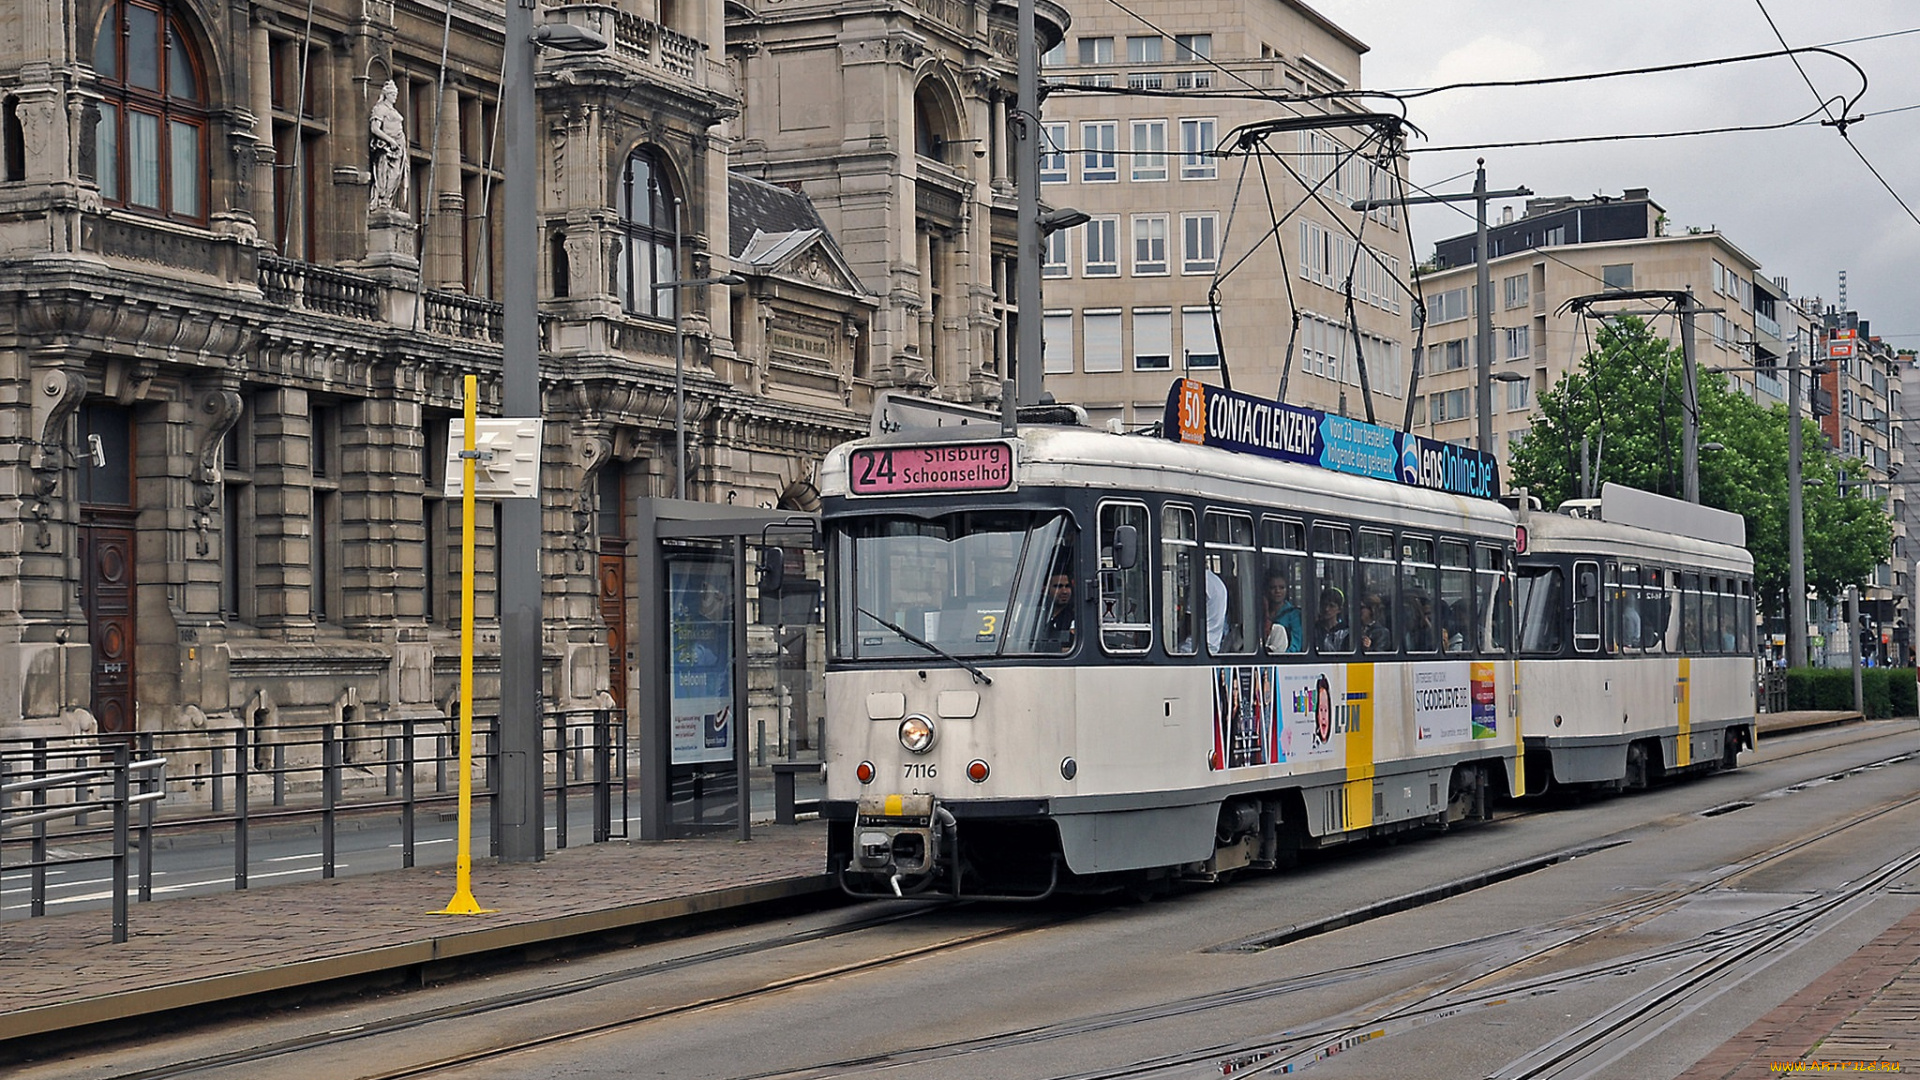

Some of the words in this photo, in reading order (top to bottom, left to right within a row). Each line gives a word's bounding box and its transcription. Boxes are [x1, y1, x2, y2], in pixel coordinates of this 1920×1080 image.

[1185, 391, 1199, 429] 50
[1209, 393, 1317, 456] CONTACTLENZEN?
[1329, 417, 1343, 439] Voor
[1344, 421, 1351, 441] 23
[1364, 423, 1384, 449] besteld
[859, 450, 896, 485] 24
[924, 447, 999, 463] Silsburg
[1327, 441, 1355, 468] Volgende
[1356, 447, 1367, 474] dag
[1368, 450, 1392, 475] geleverd
[1418, 438, 1492, 497] LensOnline.be
[903, 464, 1007, 484] Schoonselhof
[979, 615, 997, 635] 3
[904, 763, 937, 778] 7116
